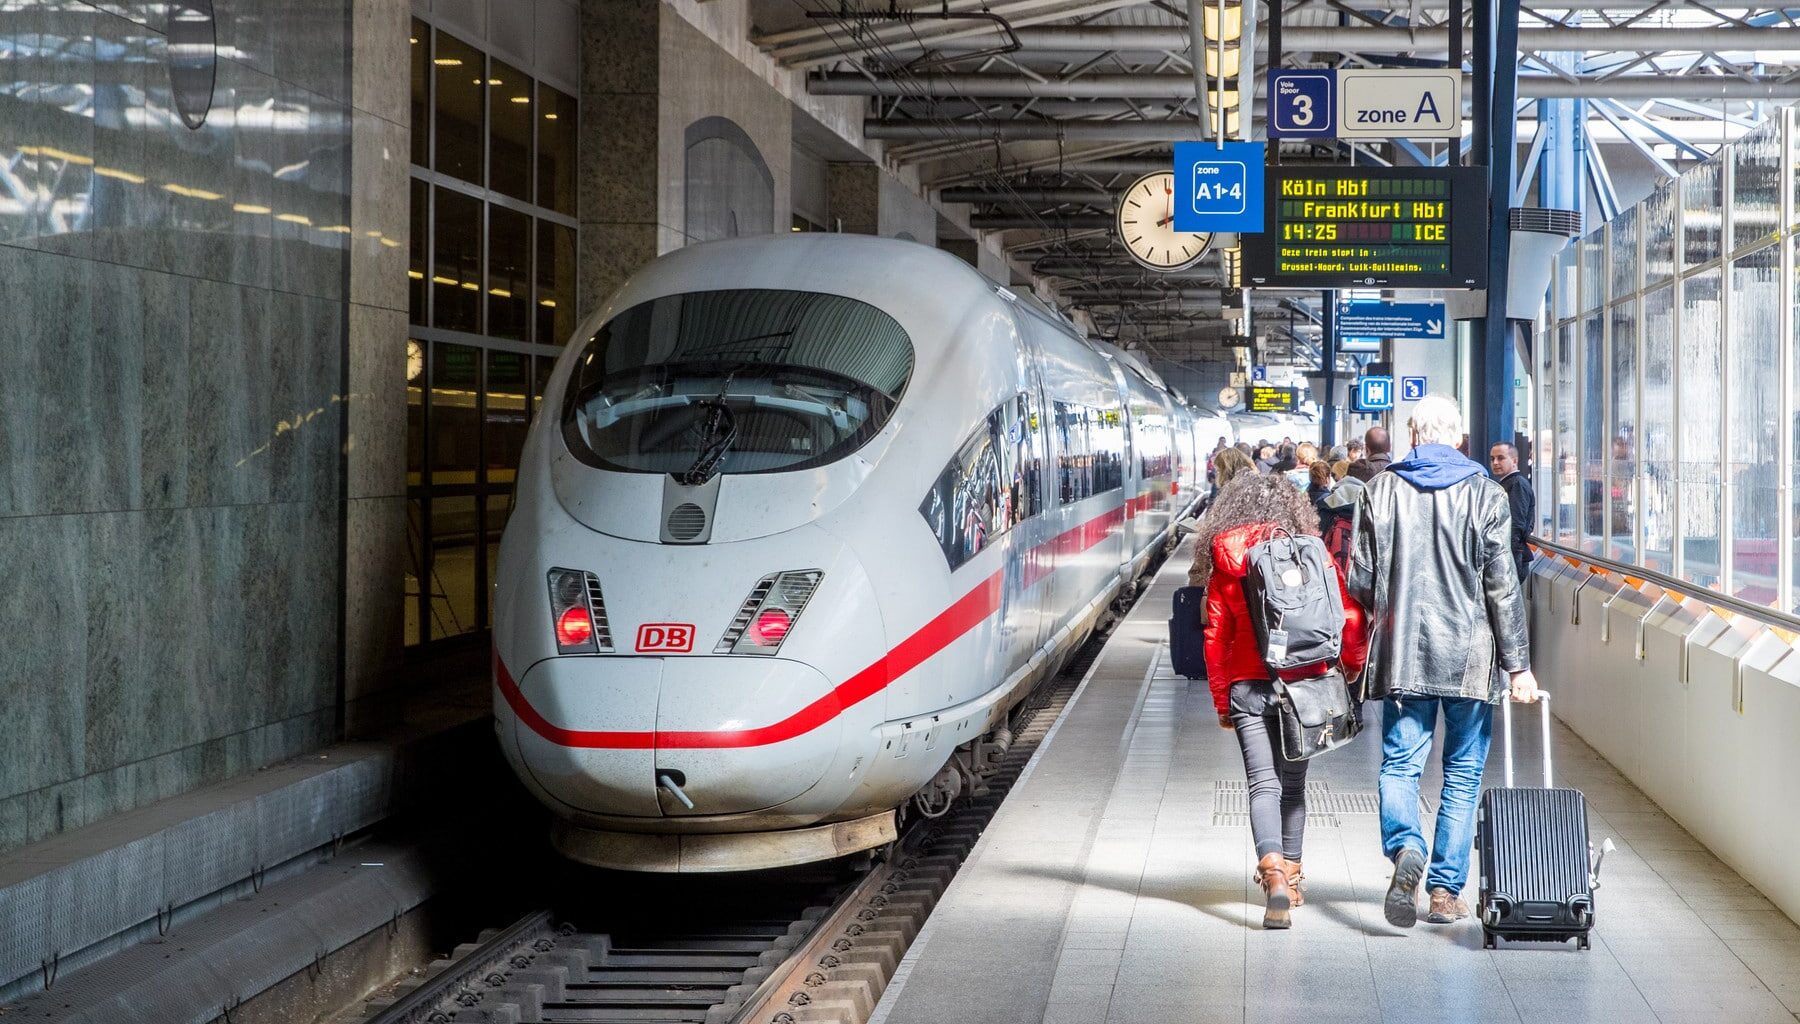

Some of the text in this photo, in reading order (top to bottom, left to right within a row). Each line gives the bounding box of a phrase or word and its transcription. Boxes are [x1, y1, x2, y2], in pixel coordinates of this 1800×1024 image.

[1292, 94, 1314, 126] 3
[1357, 91, 1442, 123] zone A
[1197, 167, 1220, 175] zone
[1282, 179, 1368, 196] Köln Hbf
[1304, 202, 1444, 218] Frankfurt Hbf
[1283, 223, 1446, 240] 14:25 ICE
[1281, 248, 1301, 257] Deze
[1305, 248, 1328, 257] trein
[1331, 248, 1354, 257] stopt
[1359, 248, 1369, 257] in
[1255, 370, 1262, 380] 3
[1410, 385, 1419, 397] 3
[643, 627, 687, 648] DB
